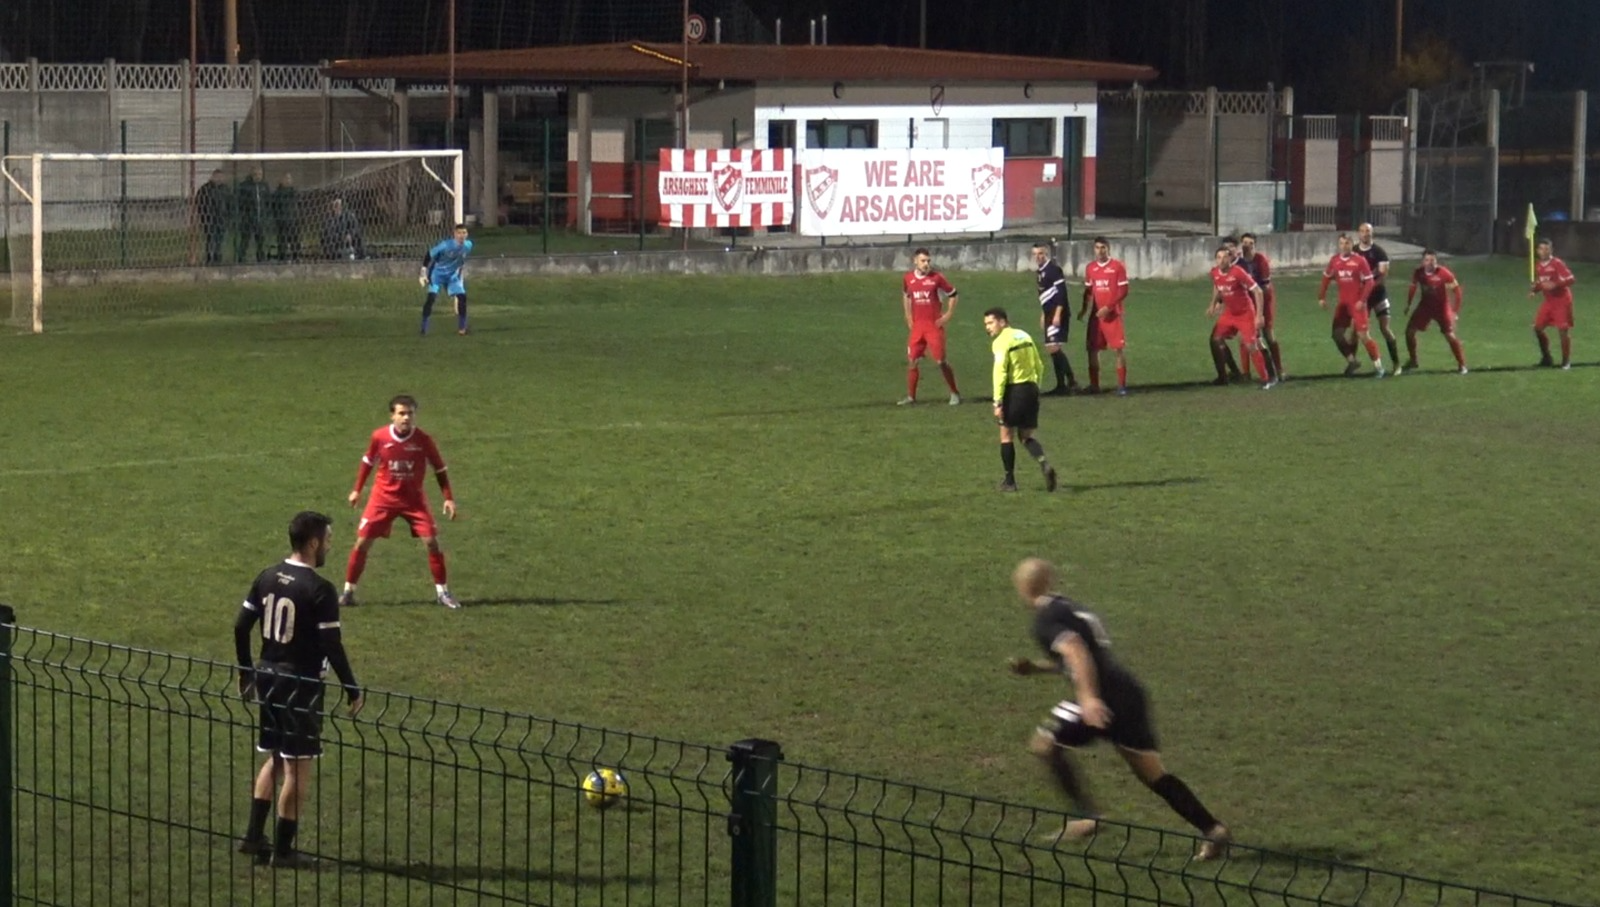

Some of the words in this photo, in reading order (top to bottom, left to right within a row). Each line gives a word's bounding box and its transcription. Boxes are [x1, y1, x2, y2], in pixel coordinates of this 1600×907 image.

[689, 22, 701, 36] 70
[864, 160, 898, 188] WE
[903, 159, 945, 188] ARE
[662, 176, 709, 196] ARSAGHESE
[745, 176, 788, 196] FEMMINILE
[839, 193, 969, 223] ARSAGHESE
[262, 593, 296, 644] 10
